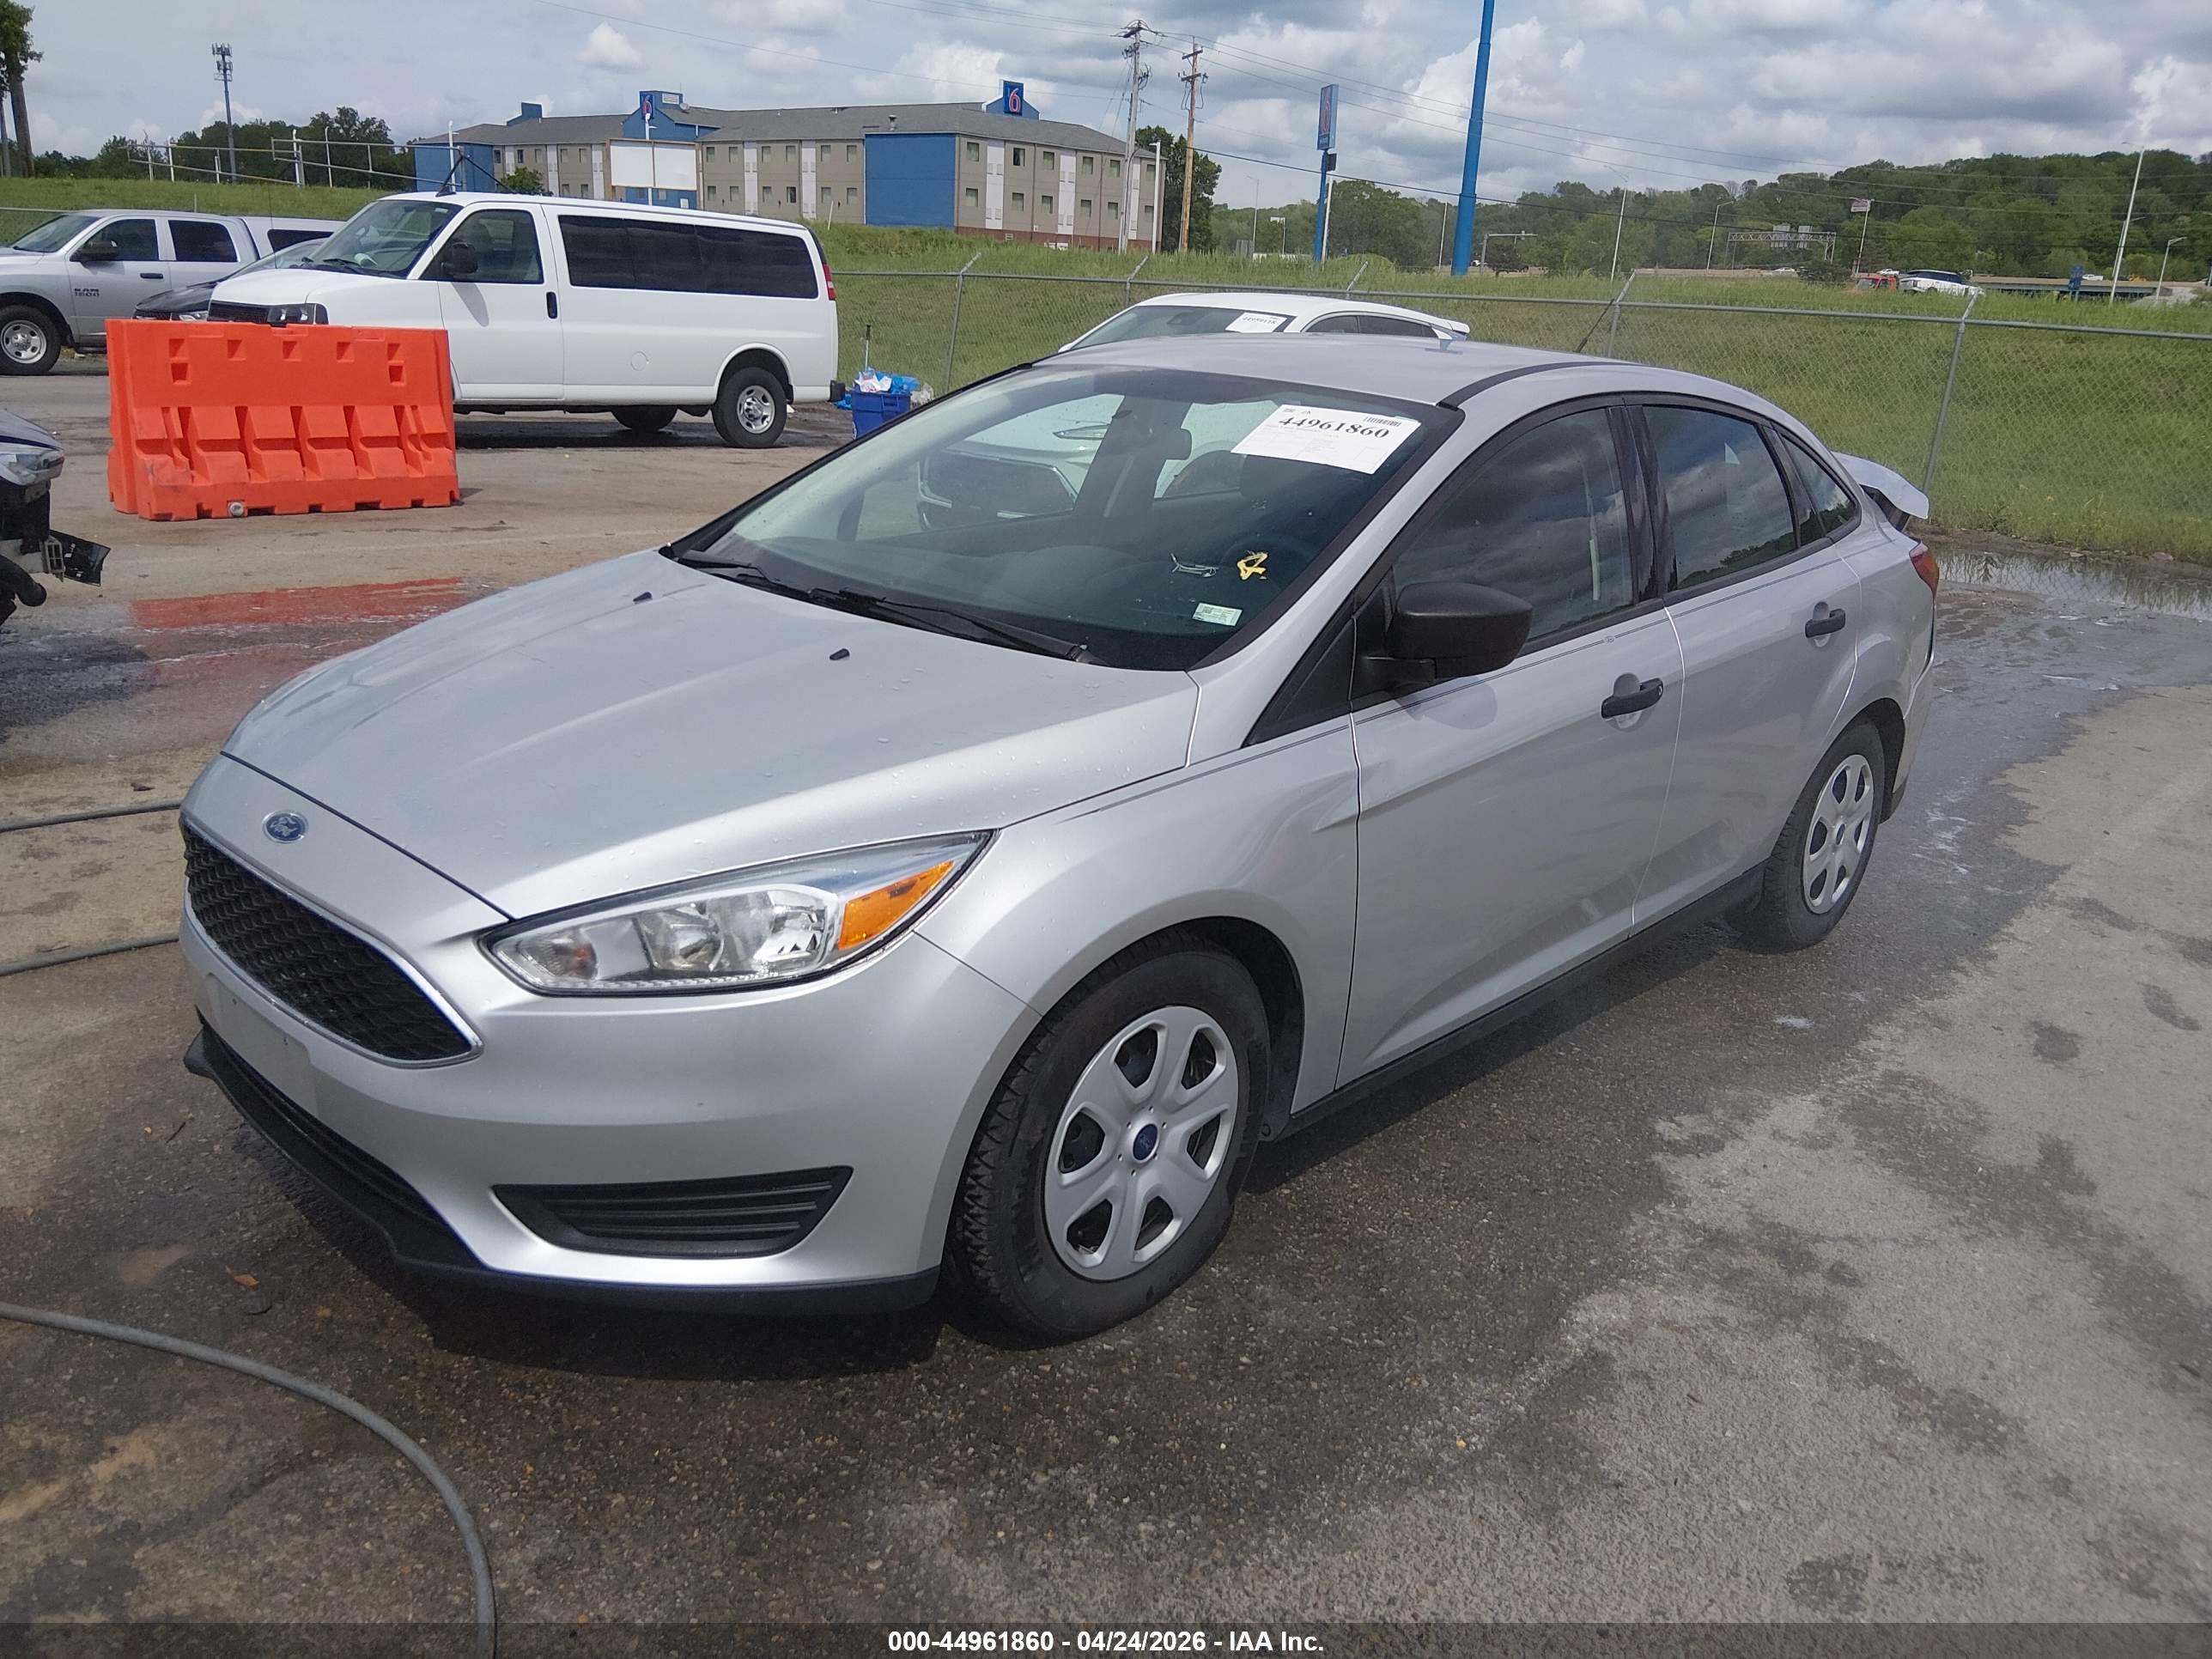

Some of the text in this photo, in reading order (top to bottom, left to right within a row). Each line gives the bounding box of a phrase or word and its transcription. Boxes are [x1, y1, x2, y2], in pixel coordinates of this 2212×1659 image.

[1009, 88, 1021, 112] 6
[1279, 416, 1390, 439] 44961860
[270, 816, 298, 837] Ford
